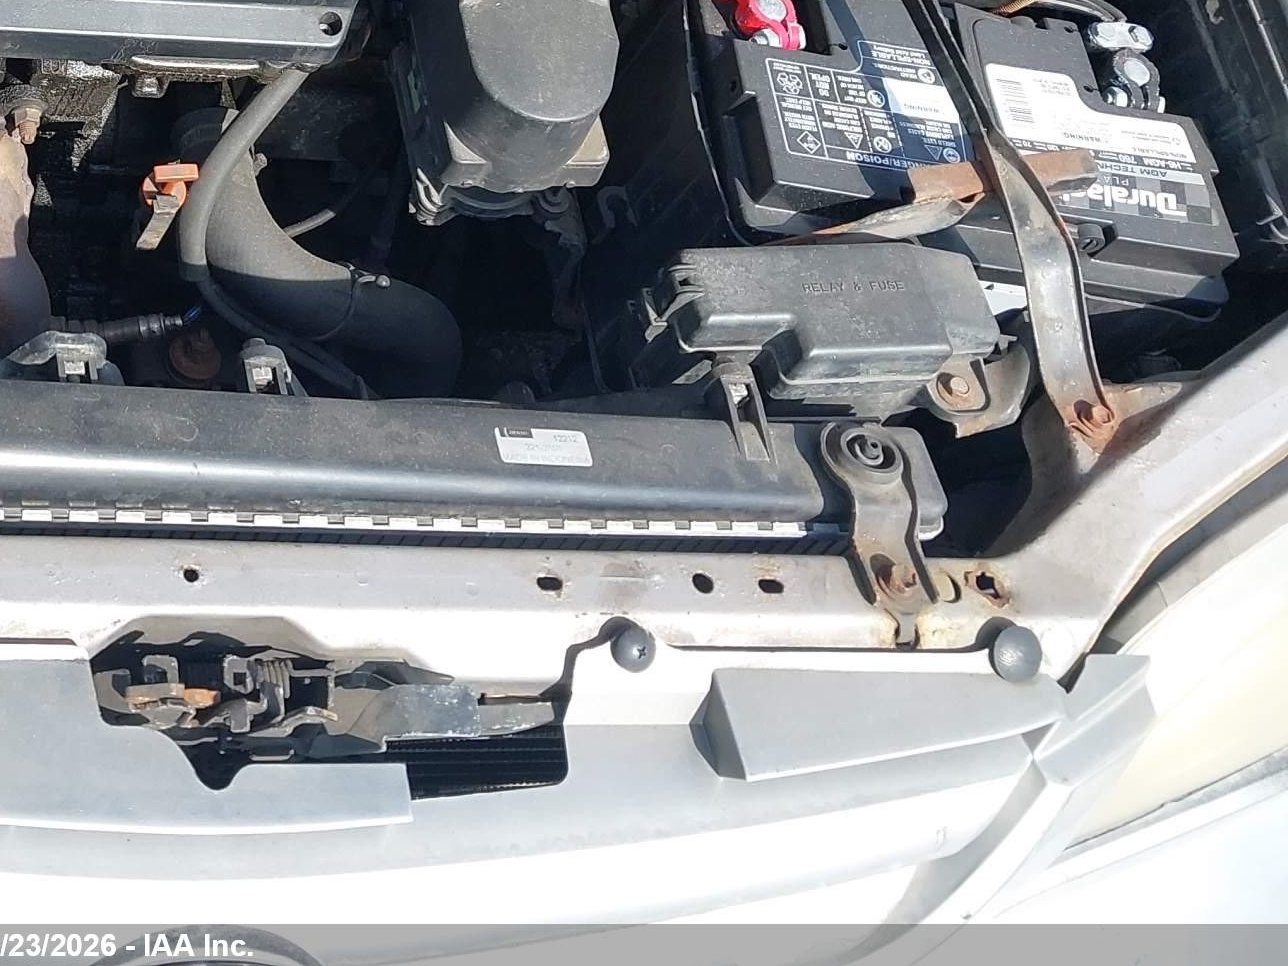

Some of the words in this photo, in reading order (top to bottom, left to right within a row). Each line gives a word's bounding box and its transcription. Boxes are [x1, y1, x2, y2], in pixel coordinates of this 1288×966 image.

[1064, 132, 1100, 143] WARNING
[847, 150, 925, 169] NGER/POISON
[1140, 167, 1166, 178] AGM
[801, 280, 845, 293] RELAY
[852, 281, 863, 292] &
[868, 279, 906, 292] FUSE
